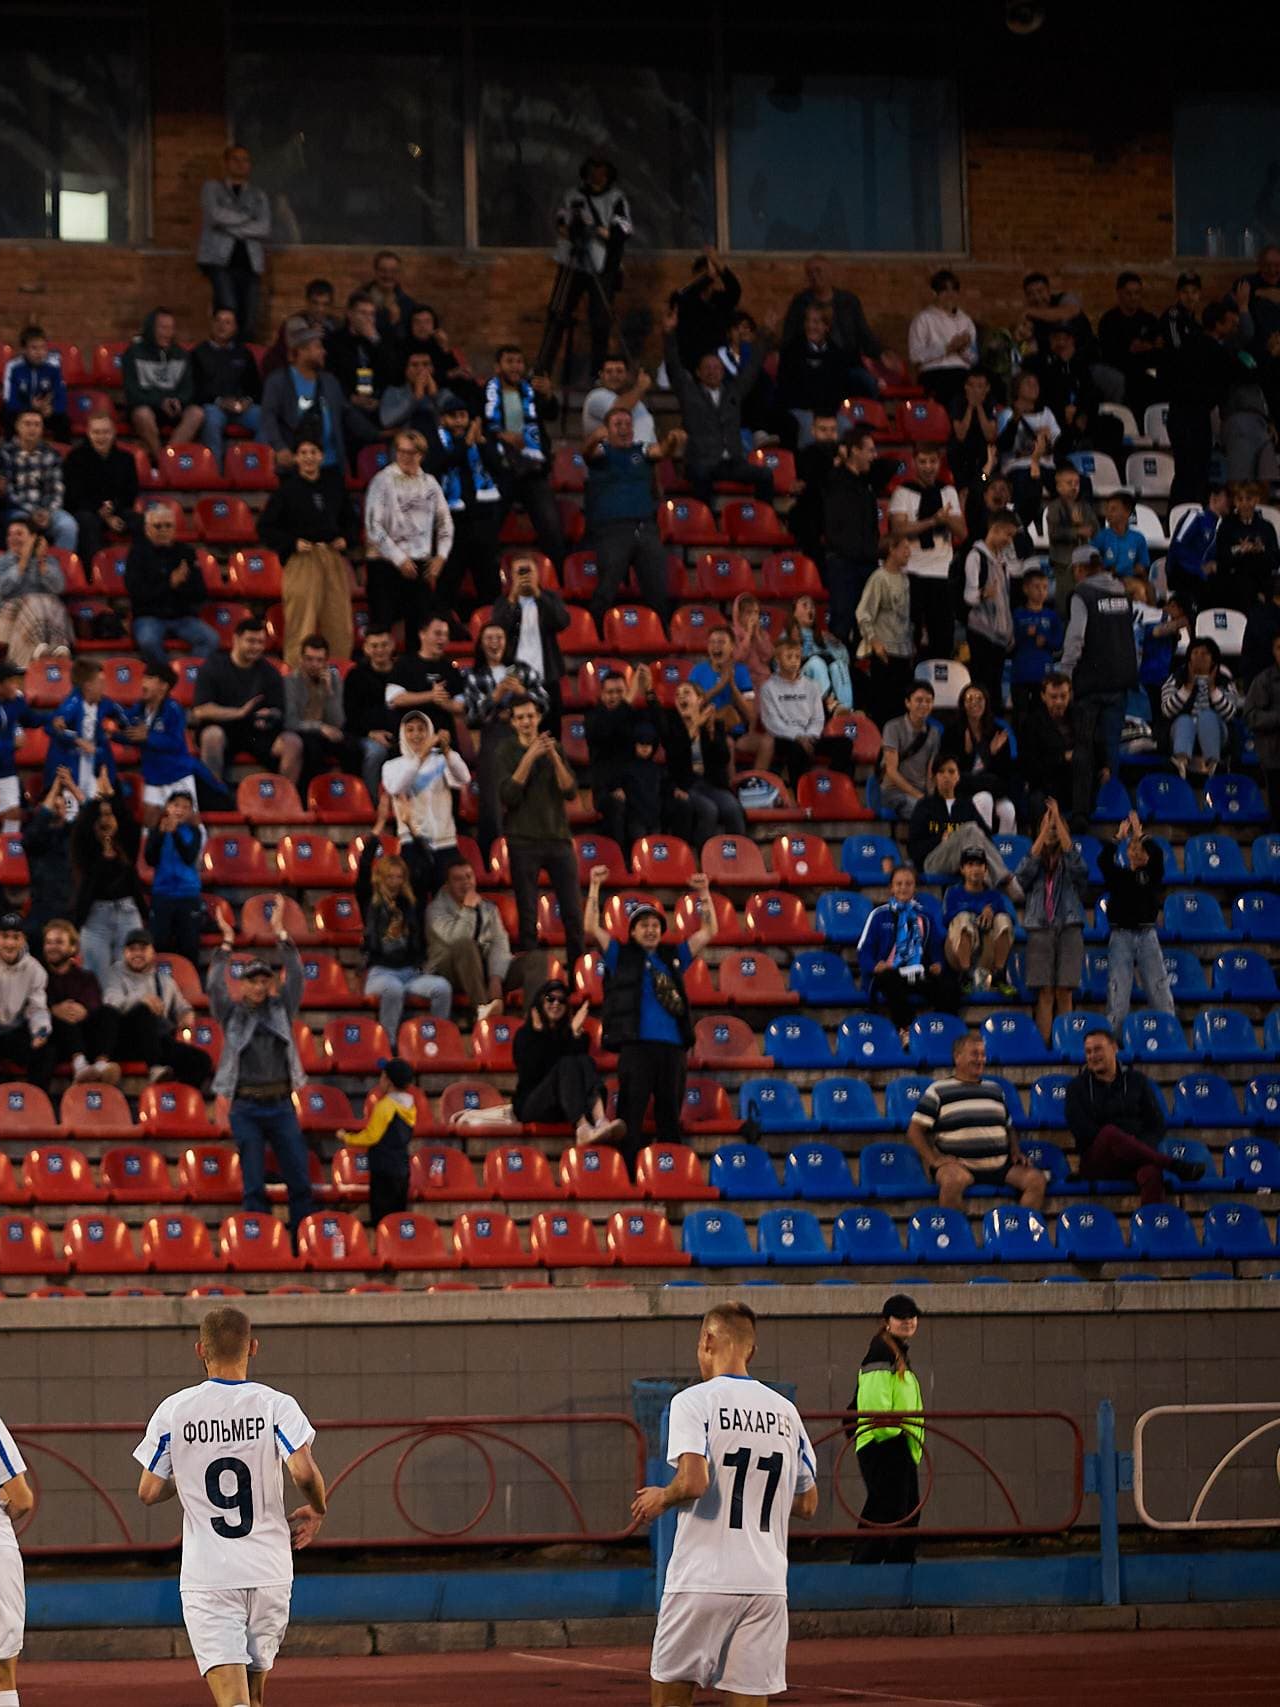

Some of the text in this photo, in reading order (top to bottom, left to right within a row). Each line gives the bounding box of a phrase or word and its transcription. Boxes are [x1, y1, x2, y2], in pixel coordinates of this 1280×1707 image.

[183, 1417, 265, 1444] ФОЛЬМЕР
[719, 1407, 791, 1438] БАХАРЕВ
[205, 1456, 254, 1539] 9
[723, 1447, 783, 1533] 11
